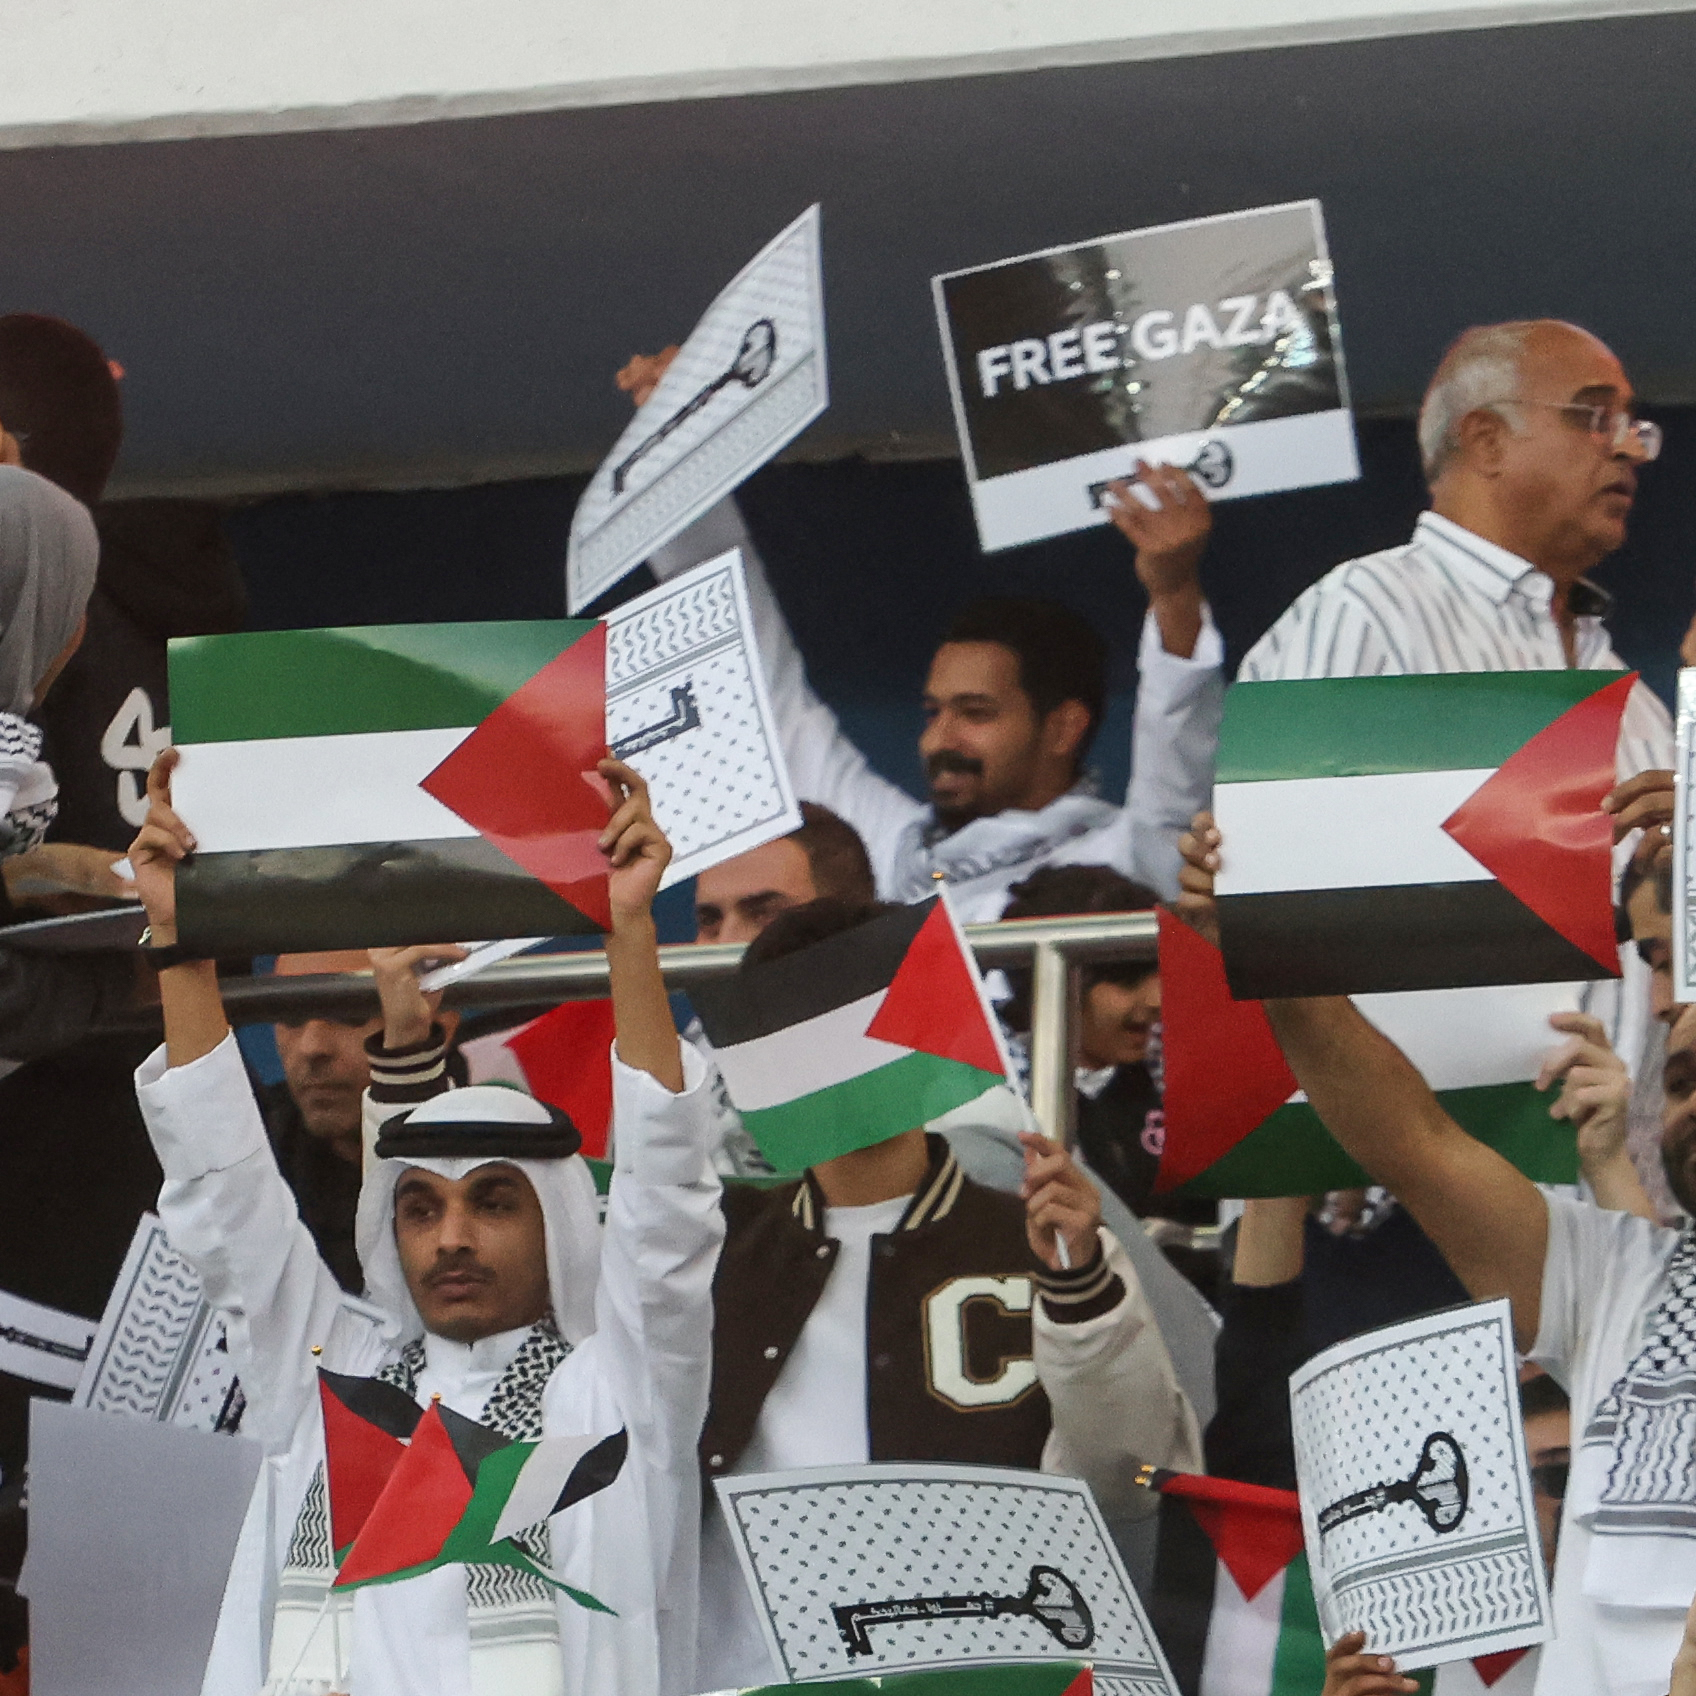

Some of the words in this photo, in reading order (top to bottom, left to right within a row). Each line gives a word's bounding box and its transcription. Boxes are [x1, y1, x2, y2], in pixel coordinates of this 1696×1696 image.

[977, 319, 1120, 398] FREE
[1130, 290, 1315, 361] GAZA
[921, 1273, 1040, 1412] C
